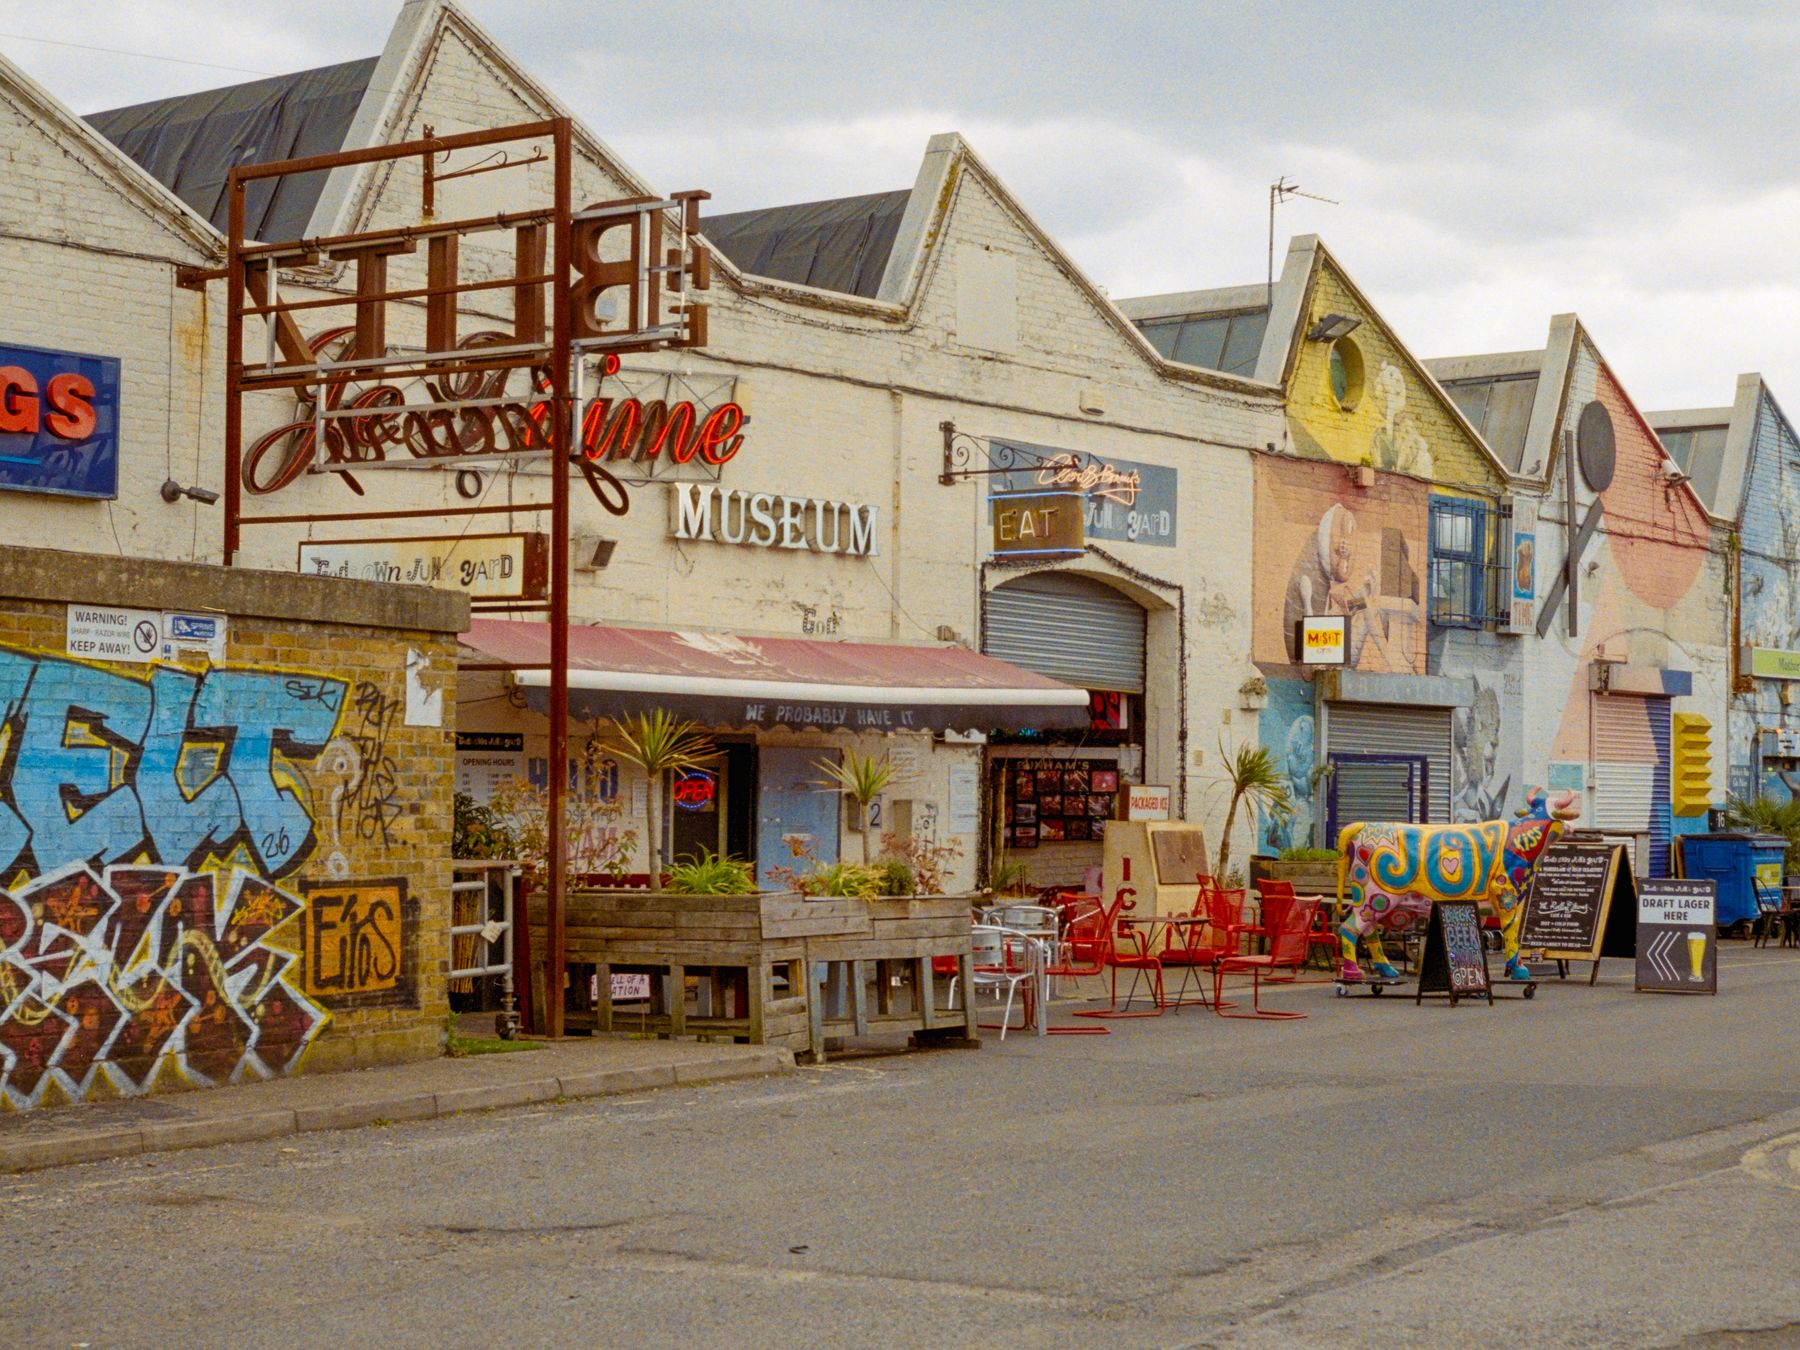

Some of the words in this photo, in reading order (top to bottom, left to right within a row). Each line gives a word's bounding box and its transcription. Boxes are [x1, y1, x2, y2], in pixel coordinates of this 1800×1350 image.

[675, 482, 880, 557] MUSEUM
[1001, 509, 1055, 541] EAT
[75, 611, 128, 626] WARNING!
[70, 640, 96, 652] KEEP
[99, 642, 131, 655] AWAY!
[745, 704, 765, 721] WE
[776, 706, 847, 725] PROBABLY
[857, 709, 892, 726] HAVE
[901, 710, 914, 725] IT
[463, 758, 491, 767] OPENING
[493, 758, 516, 767] HOURS
[673, 779, 717, 801] OPEN
[870, 803, 881, 827] 2
[261, 827, 291, 859] 26
[1374, 822, 1500, 897] JOY
[1642, 898, 1674, 908] DRAFT
[1678, 899, 1710, 909] LAGER
[1664, 911, 1689, 921] HERE
[1452, 967, 1485, 986] OPEN
